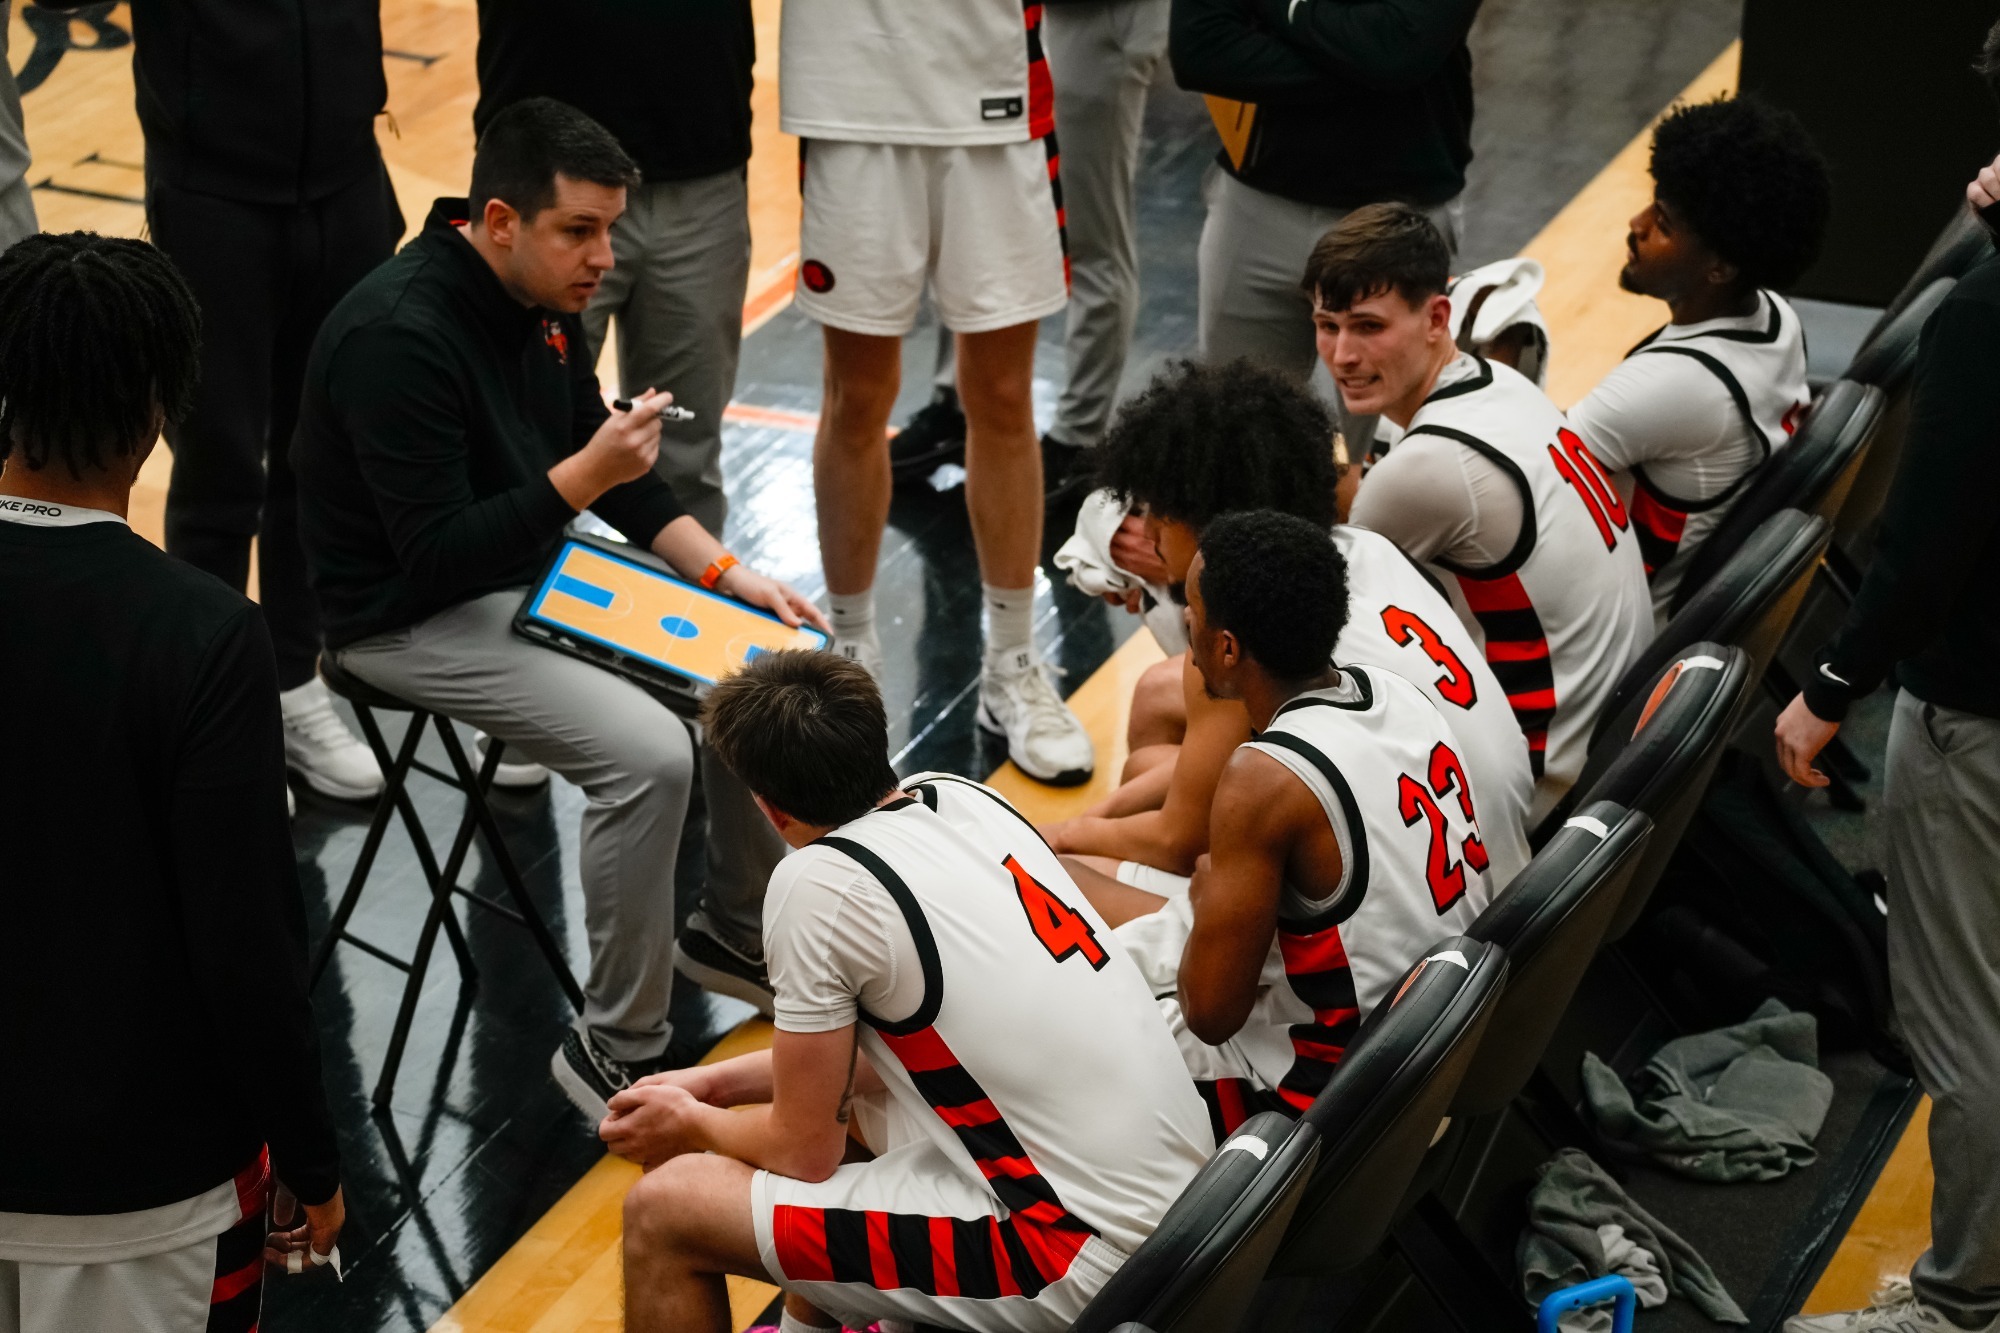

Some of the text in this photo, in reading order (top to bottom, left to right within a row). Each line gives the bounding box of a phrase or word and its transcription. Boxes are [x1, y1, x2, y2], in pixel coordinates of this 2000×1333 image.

[0, 500, 62, 517] KE PRO
[1547, 426, 1629, 554] 10
[1380, 605, 1477, 710] 3
[1398, 741, 1490, 916] 23
[1001, 853, 1111, 972] 4
